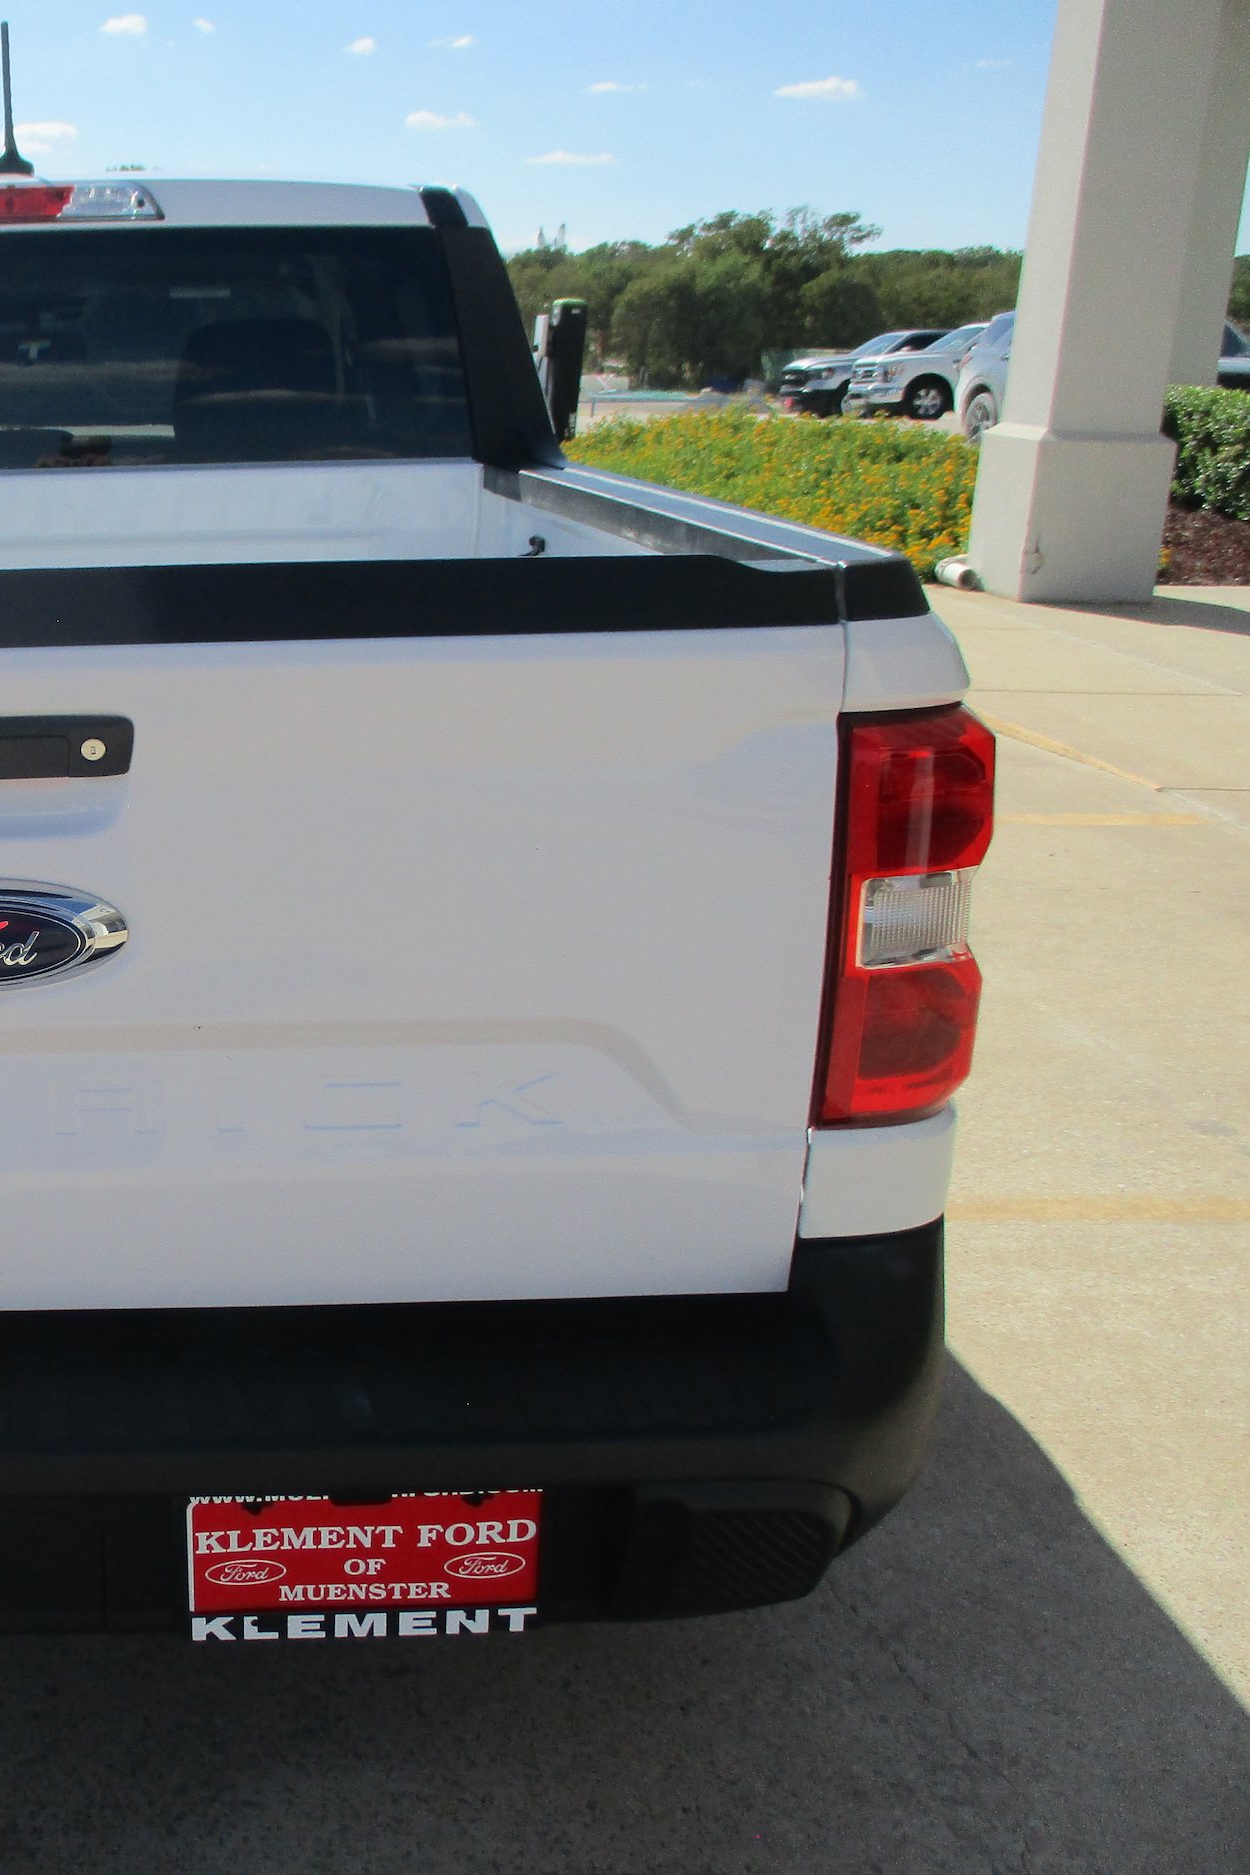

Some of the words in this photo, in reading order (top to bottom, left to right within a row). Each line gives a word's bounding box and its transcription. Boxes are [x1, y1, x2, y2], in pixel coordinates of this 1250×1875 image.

[194, 1525, 404, 1554] KLEMENT
[416, 1519, 537, 1548] FORD
[220, 1563, 269, 1582] Ford
[343, 1558, 387, 1576] OF
[458, 1555, 509, 1575] Ford
[278, 1582, 452, 1602] MUENSTER
[191, 1607, 538, 1642] KLEMENT
